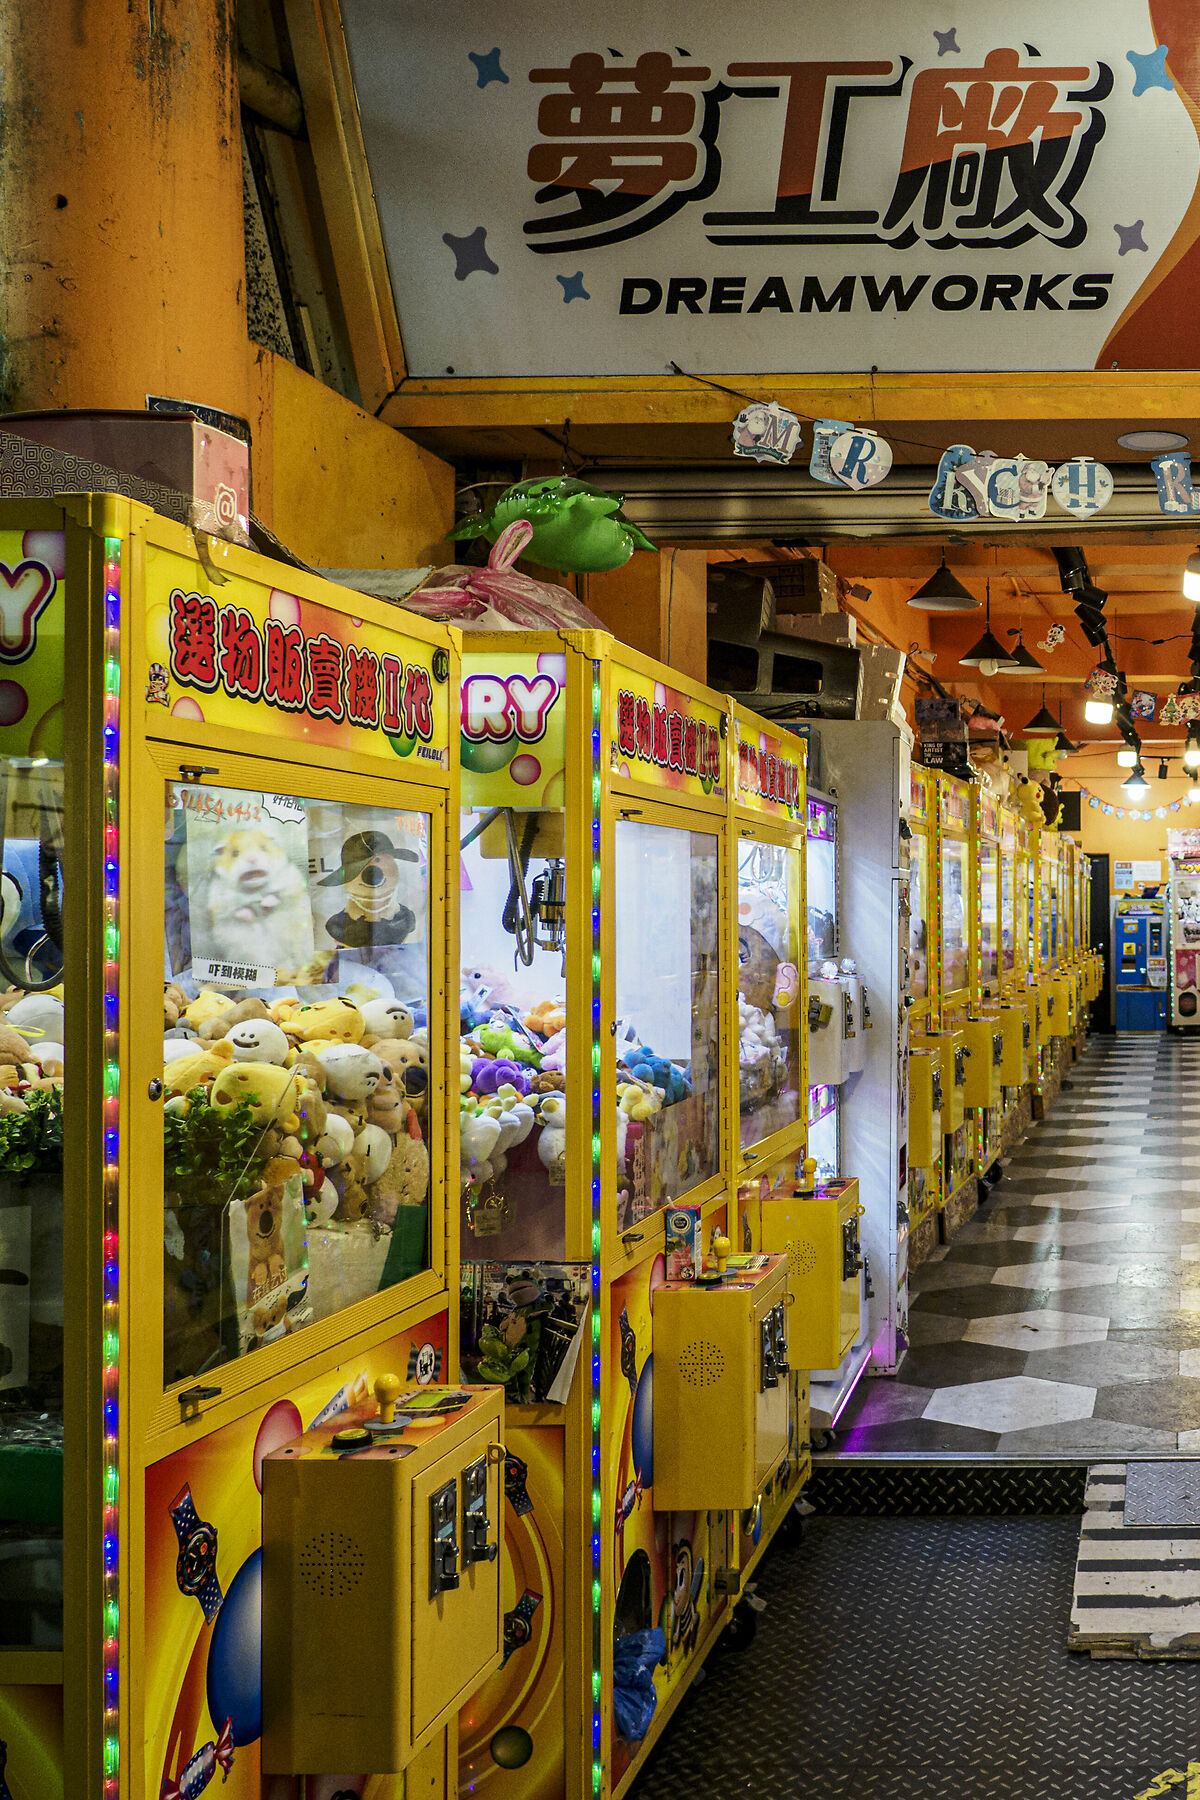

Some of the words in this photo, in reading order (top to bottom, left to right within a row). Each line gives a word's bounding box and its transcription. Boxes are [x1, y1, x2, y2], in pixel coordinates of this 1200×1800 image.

[523, 45, 1110, 252] 夢工廠
[619, 273, 1114, 315] DREAMWORKS
[461, 673, 560, 743] RY
